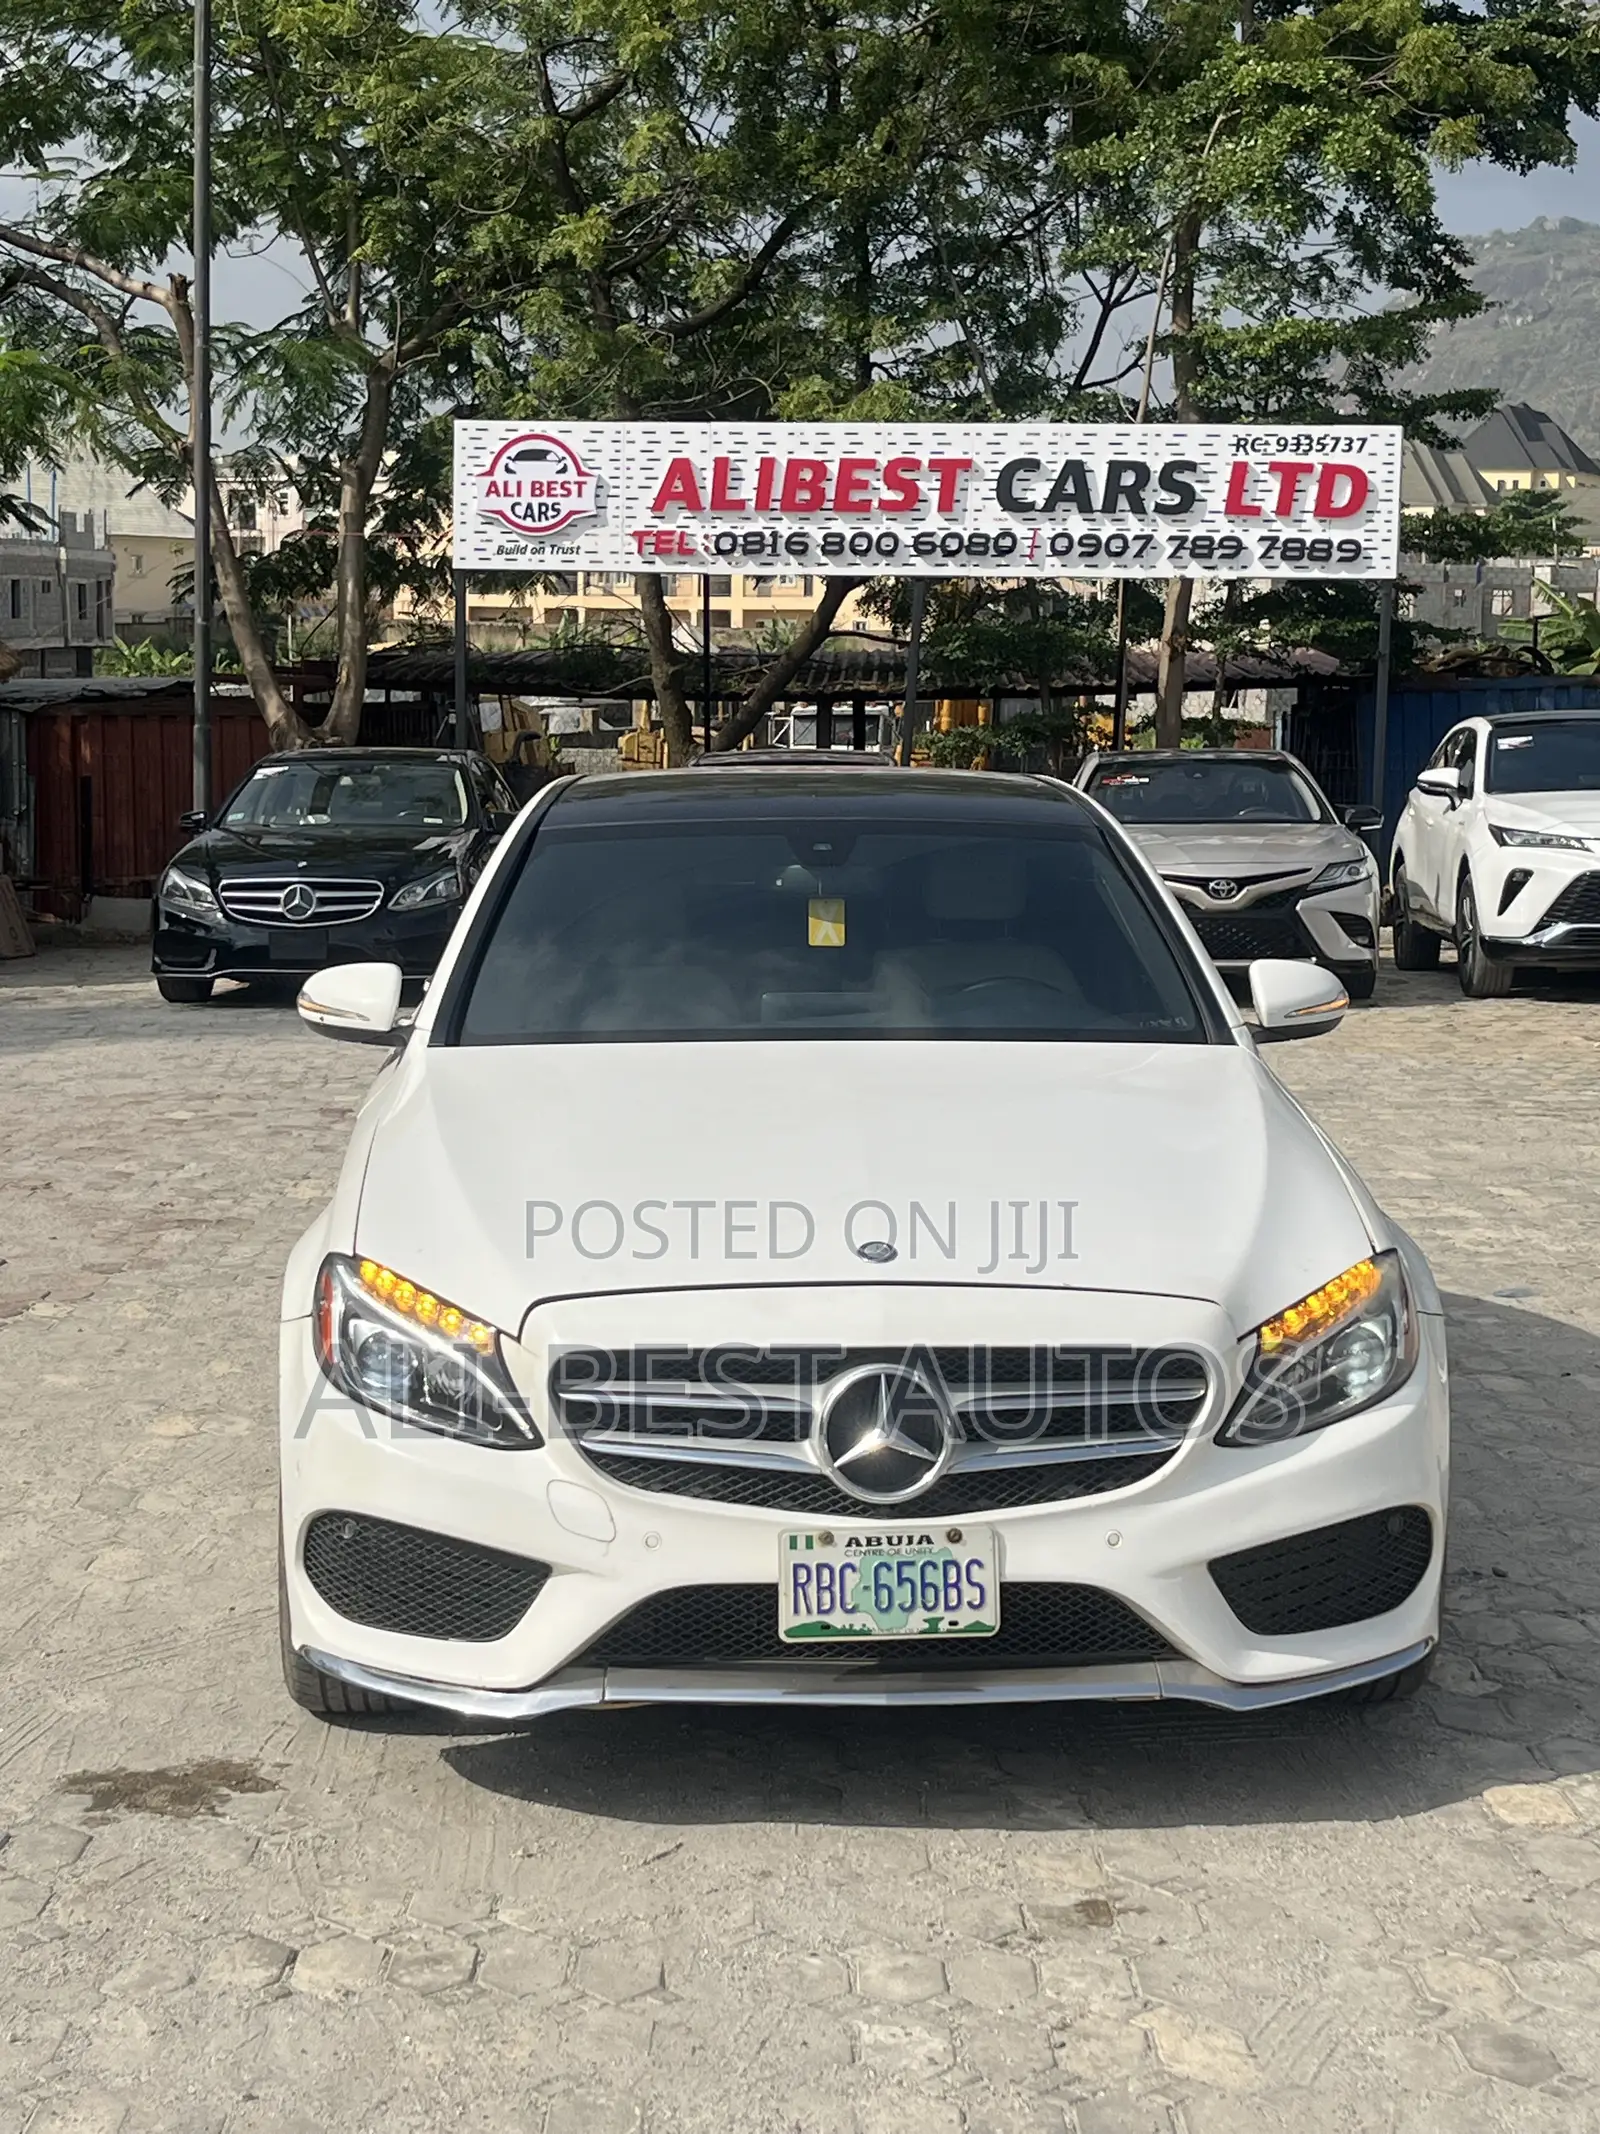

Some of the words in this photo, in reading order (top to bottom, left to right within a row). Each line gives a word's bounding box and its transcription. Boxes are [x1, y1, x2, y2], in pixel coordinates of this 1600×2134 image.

[1275, 436, 1368, 454] 9335737
[485, 480, 522, 498] ALI
[530, 480, 587, 499] BEST
[651, 457, 974, 513] ALIBEST
[995, 458, 1198, 516] CARS
[1223, 461, 1369, 518] LTD
[511, 502, 561, 522] CARS
[496, 544, 528, 556] Build
[530, 546, 545, 556] on
[549, 544, 581, 556] Trust
[714, 530, 809, 556] 0816
[821, 531, 899, 556] 800
[912, 531, 1018, 557] 6080
[1049, 532, 1154, 559] 0907
[1167, 534, 1245, 560] 789
[1257, 536, 1362, 562] 7889
[844, 1534, 935, 1548] ABUJA
[844, 1548, 886, 1557] CENTRE
[887, 1547, 902, 1557] OF
[904, 1546, 935, 1556] UNITY
